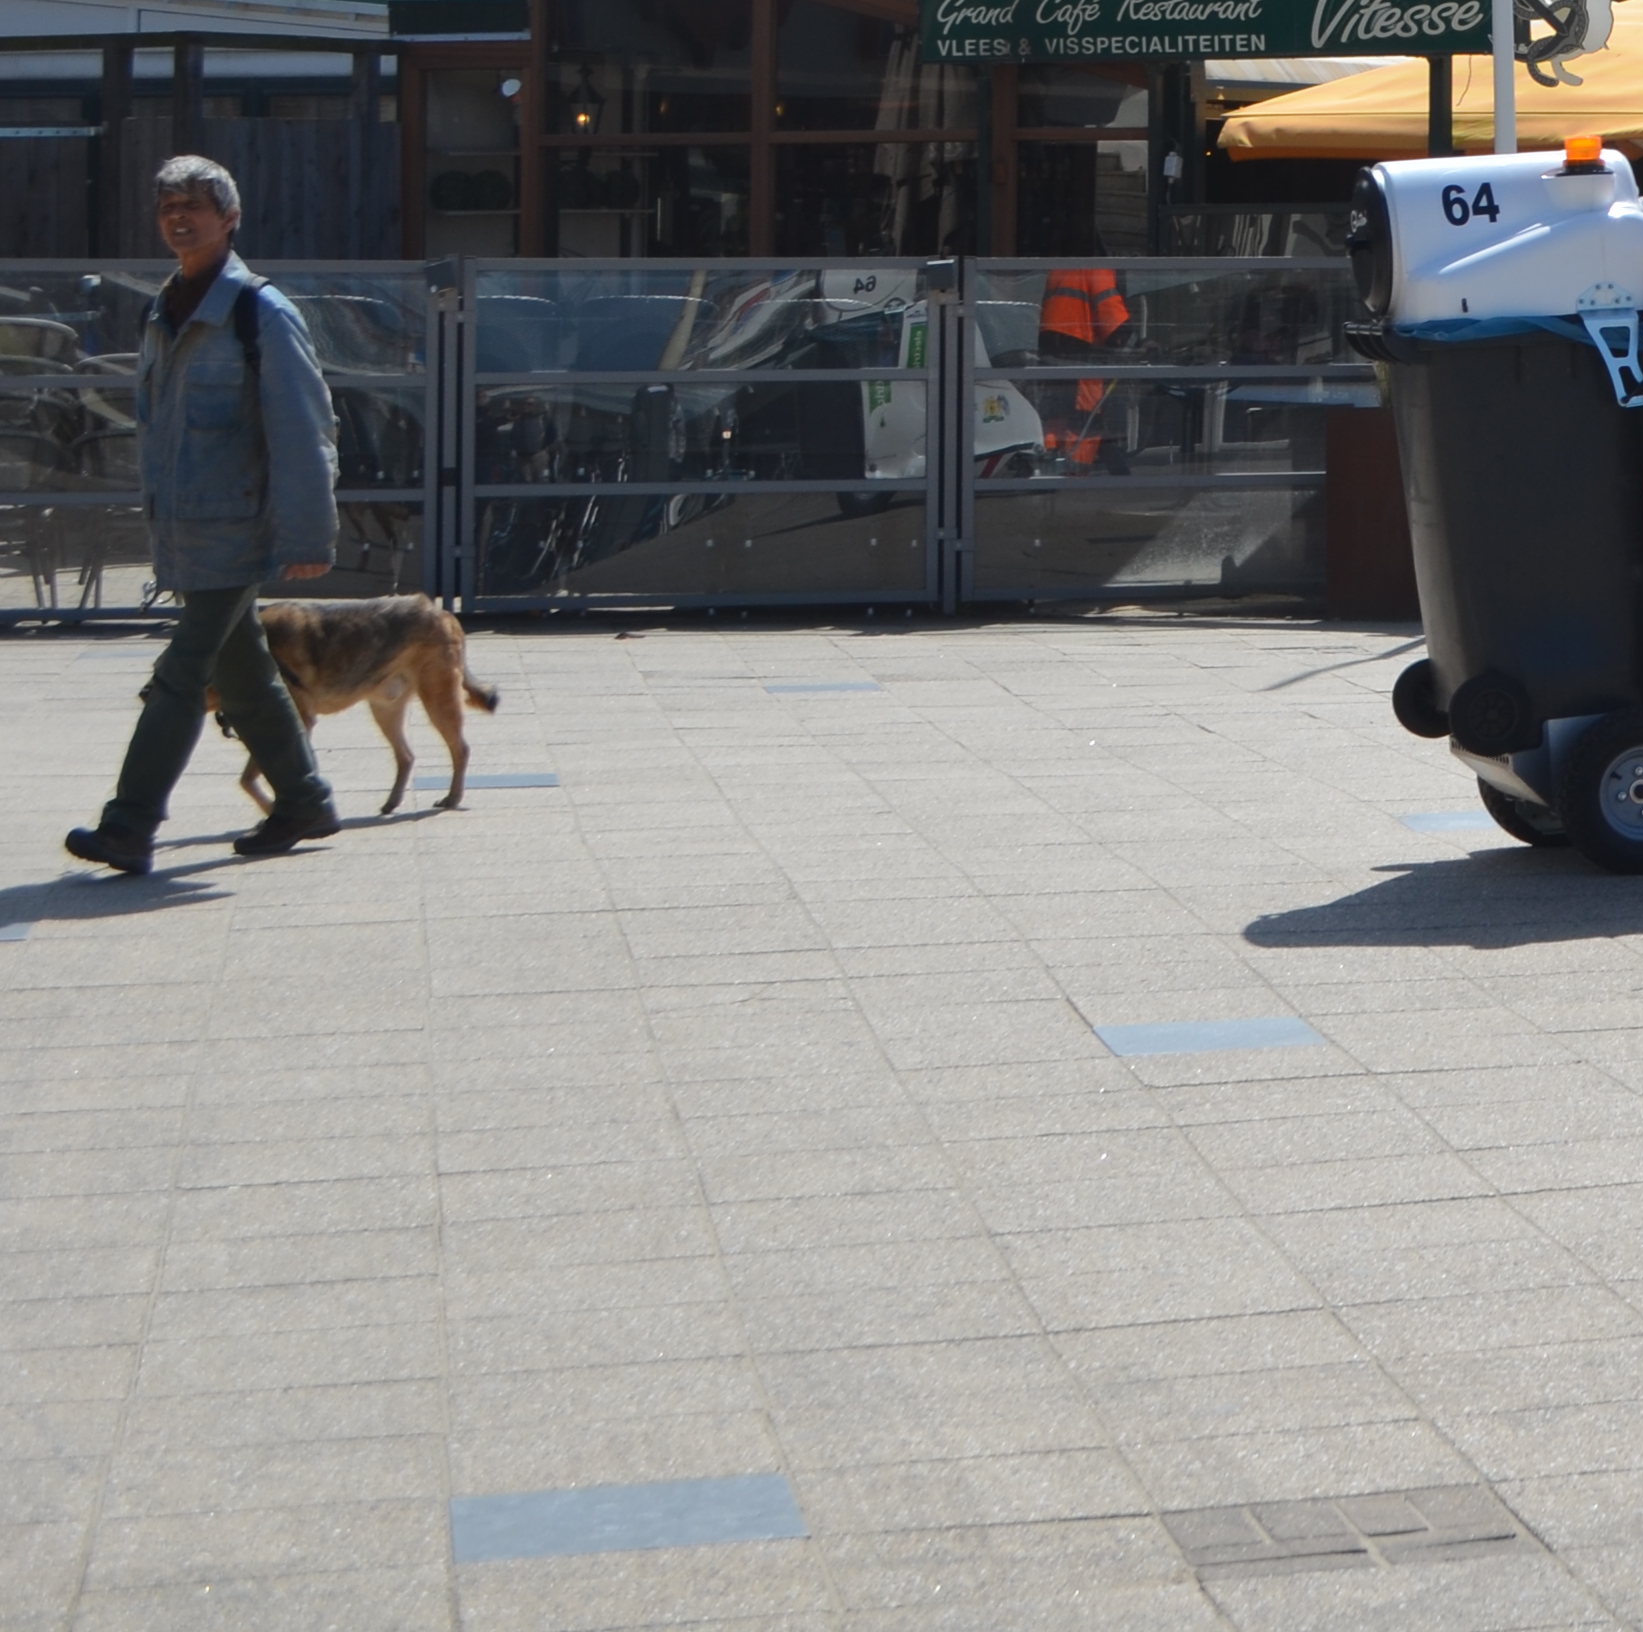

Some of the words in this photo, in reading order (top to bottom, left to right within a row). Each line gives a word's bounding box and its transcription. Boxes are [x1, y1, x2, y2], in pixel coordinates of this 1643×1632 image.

[1018, 37, 1031, 56] &
[1045, 33, 1267, 55] VISSPECIALITEITEN
[1441, 182, 1500, 226] 64
